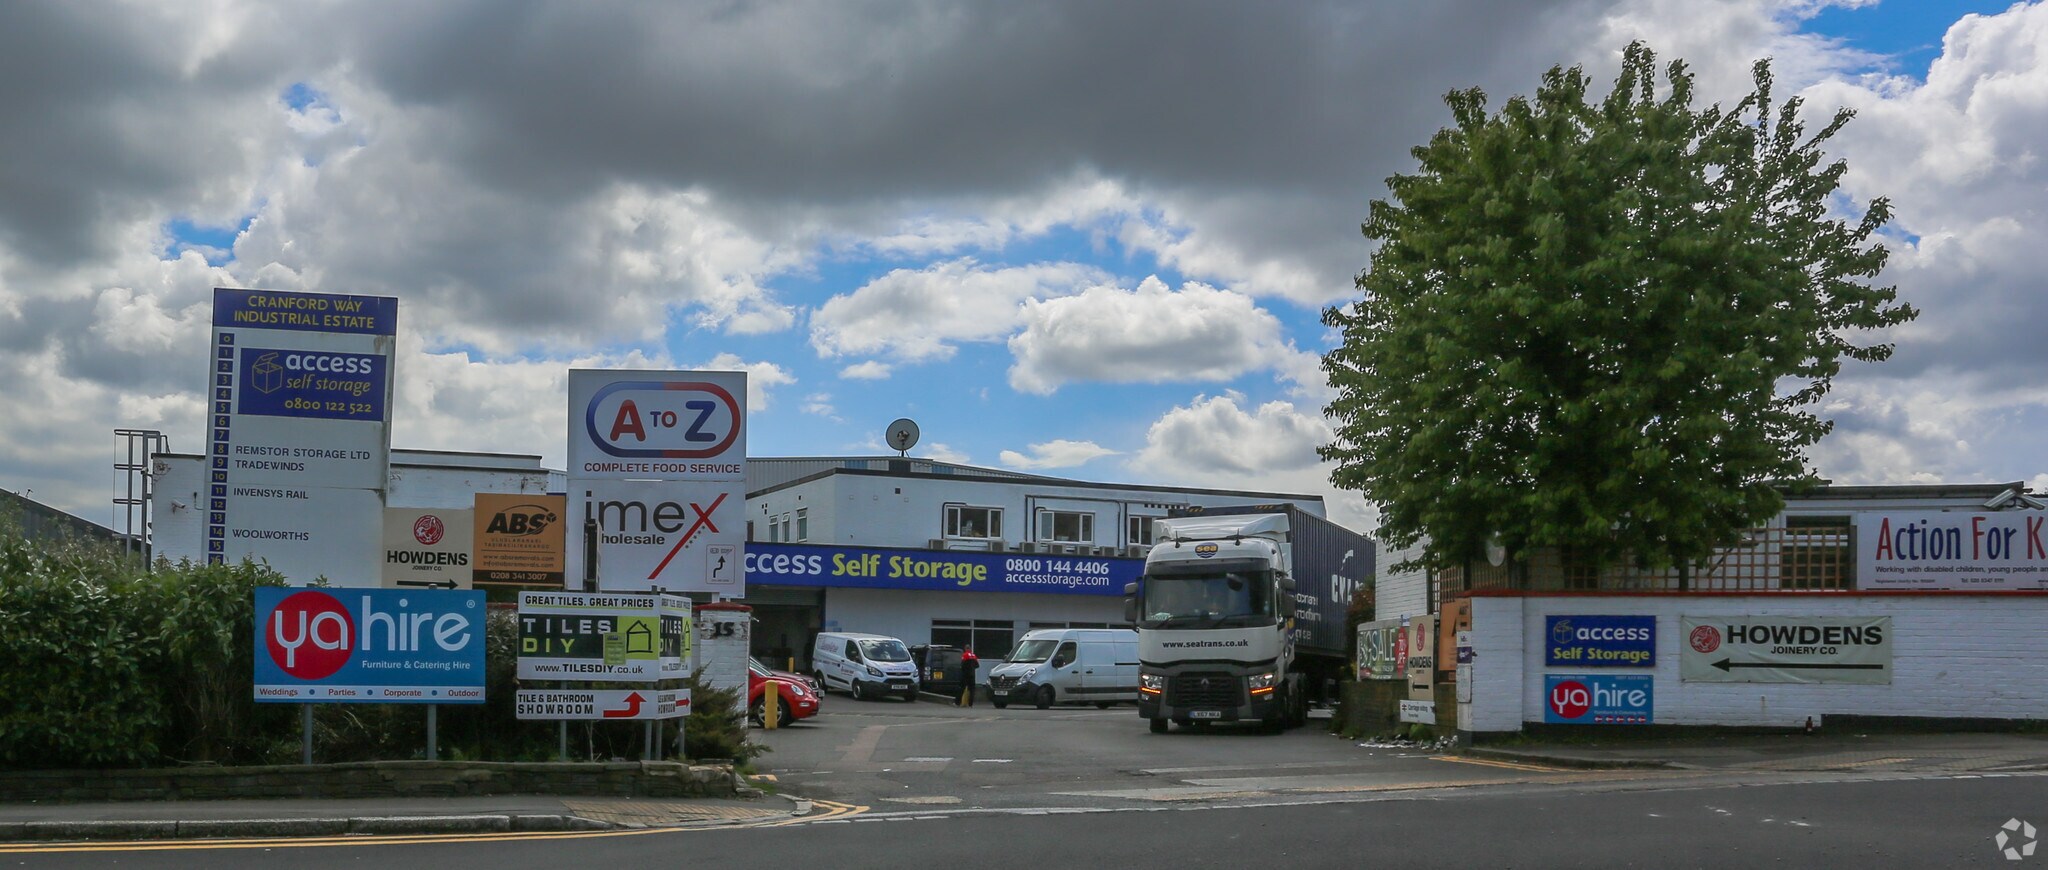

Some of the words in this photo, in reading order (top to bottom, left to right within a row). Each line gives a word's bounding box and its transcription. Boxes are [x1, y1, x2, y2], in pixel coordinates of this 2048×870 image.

[248, 296, 328, 310] CRANFORD
[334, 300, 362, 312] WAY
[234, 311, 320, 326] INDUSTRIAL
[324, 315, 374, 328] ESTATE
[286, 354, 372, 374] access
[222, 376, 228, 384] 3
[286, 374, 314, 389] self
[316, 378, 370, 396] storage
[220, 389, 227, 398] 4
[220, 403, 226, 412] 5
[284, 397, 320, 410] 0800
[326, 402, 346, 411] 122
[350, 403, 372, 414] 522
[220, 417, 226, 426] 6
[610, 399, 646, 442] A
[650, 410, 678, 428] TO
[684, 400, 716, 442] Z
[218, 430, 225, 440] 7
[218, 444, 224, 454] 8
[236, 445, 290, 457] REMSTOR
[294, 448, 347, 460] STORAGE
[350, 450, 370, 460] LTD
[218, 458, 224, 467] 9
[235, 460, 304, 471] TRADEWINDS
[584, 462, 649, 472] COMPLETE
[652, 464, 686, 473] FOOD
[690, 464, 741, 474] SERVICE
[234, 488, 284, 498] INVENSYS
[286, 490, 308, 500] RAIL
[214, 514, 222, 522] 13
[486, 512, 546, 535] ABS
[212, 527, 223, 537] 14
[232, 528, 310, 541] WOOLWORTHS
[1876, 517, 1962, 560] Action
[1972, 516, 2017, 560] For
[601, 533, 665, 545] holesale
[212, 541, 221, 550] 15
[387, 550, 468, 566] HOWDENS
[744, 553, 822, 576] ccess
[832, 553, 881, 577] Self
[888, 556, 987, 586] Storage
[1006, 558, 1041, 572] 0800
[1046, 560, 1071, 573] 144
[1074, 562, 1109, 574] 4406
[1876, 566, 1904, 574] Working
[2012, 566, 2038, 574] people
[1006, 572, 1110, 588] accessstorage.com
[525, 596, 556, 605] GREAT
[589, 598, 619, 607] GREAT
[621, 598, 654, 608] PRICES
[523, 618, 612, 634] TILES
[660, 619, 682, 634] TILES
[714, 622, 735, 637] 15
[1576, 626, 1650, 640] access
[1727, 624, 1883, 646] HOWDENS
[522, 638, 575, 654] DIY
[1162, 638, 1248, 649] www.seatrans.co.uk
[1372, 628, 1396, 662] SALE
[1553, 648, 1584, 660] Self
[1586, 648, 1650, 663] Storage
[1770, 646, 1818, 656] JOINERY
[1820, 646, 1838, 656] CO.
[362, 660, 402, 669] Furniture
[414, 661, 450, 671] Catering
[452, 661, 470, 670] Hire
[1410, 656, 1432, 668] HOWDENS
[535, 662, 644, 675] www.TILESDIY.co.uk
[259, 688, 298, 697] Weddings
[328, 688, 356, 696] Parties
[384, 688, 422, 698] Corporate
[448, 689, 479, 697] Outdoor
[518, 694, 538, 703] TILE
[538, 694, 544, 703] &
[546, 694, 594, 704] BATHROOM
[518, 704, 594, 714] SHOWROOM
